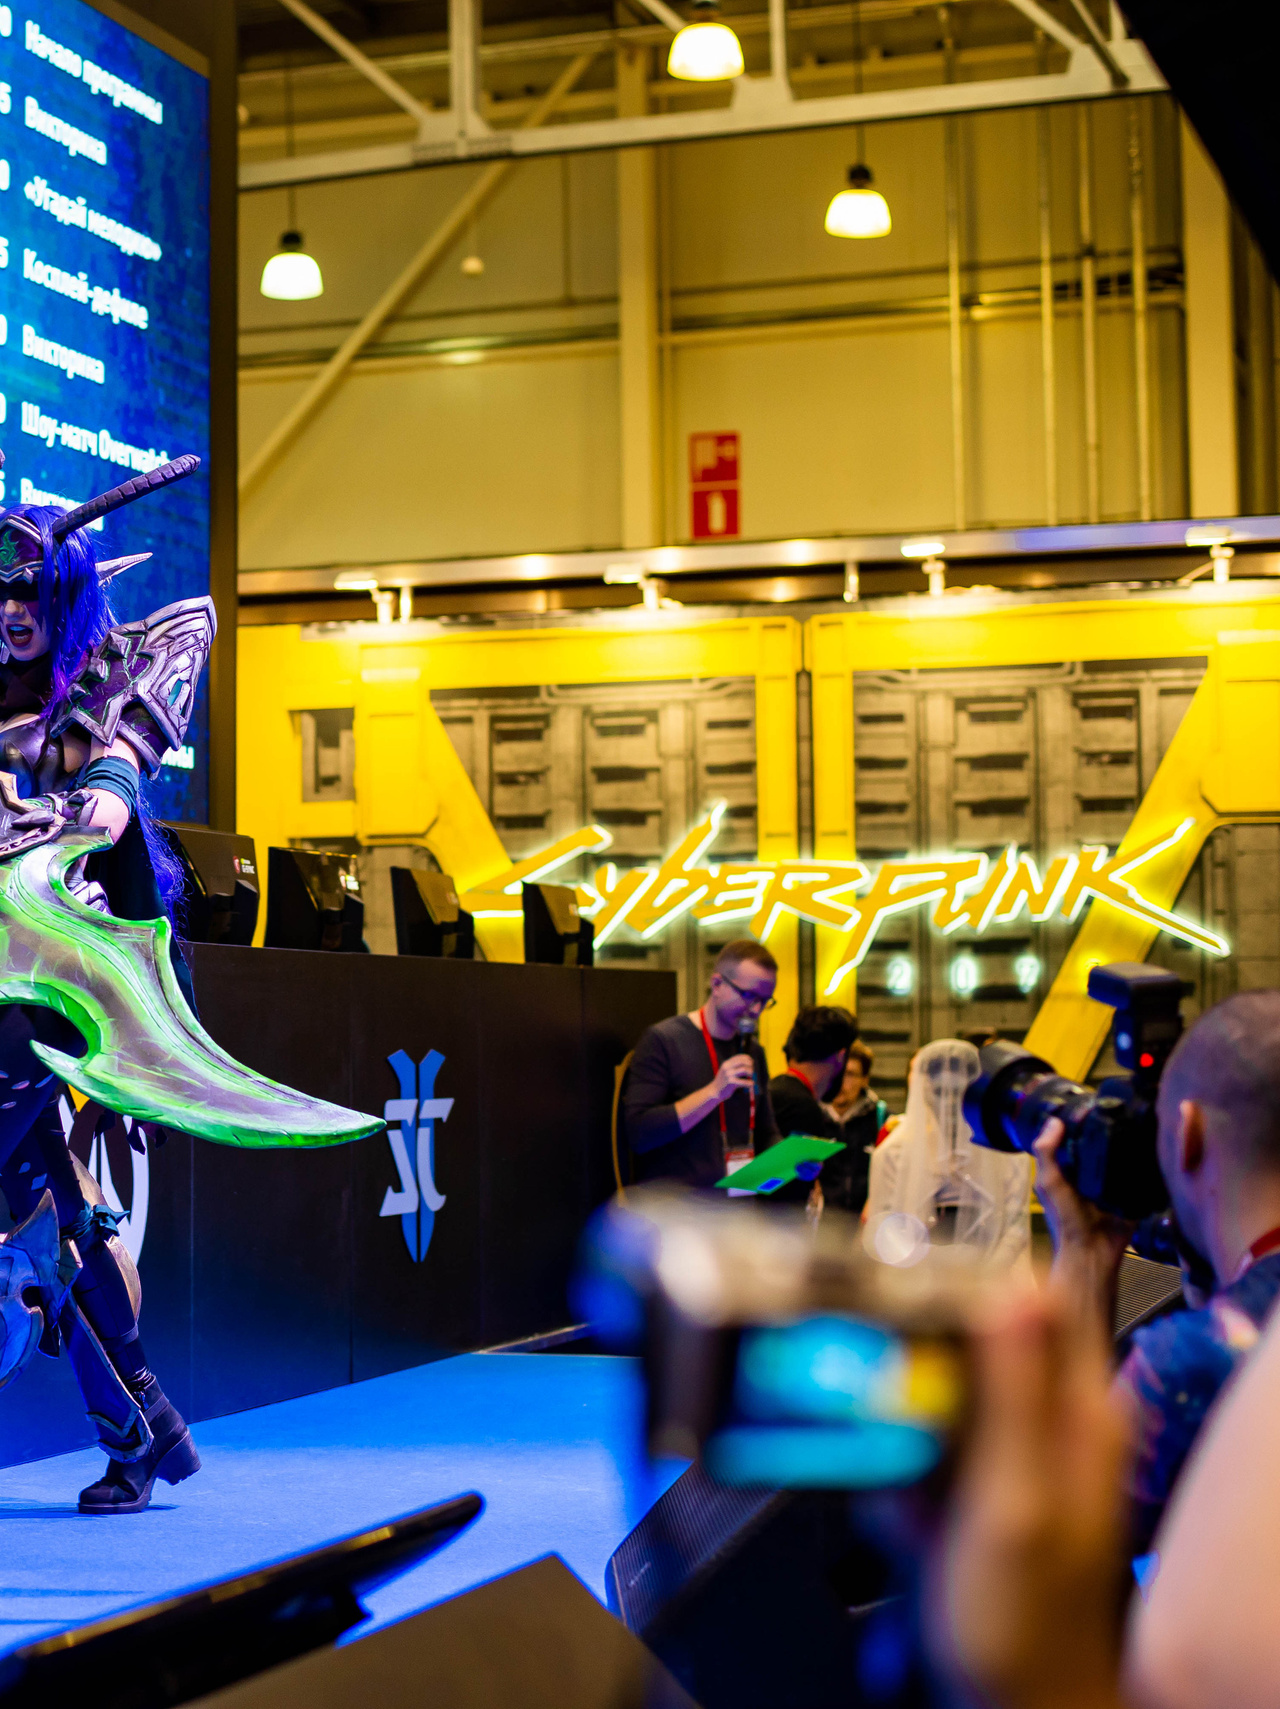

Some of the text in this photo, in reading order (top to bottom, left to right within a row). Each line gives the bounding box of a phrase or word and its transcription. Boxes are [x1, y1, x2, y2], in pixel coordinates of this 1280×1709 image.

[25, 96, 107, 165] Викторина
[23, 324, 105, 384] Викторина
[21, 401, 98, 456] Шоу-матч
